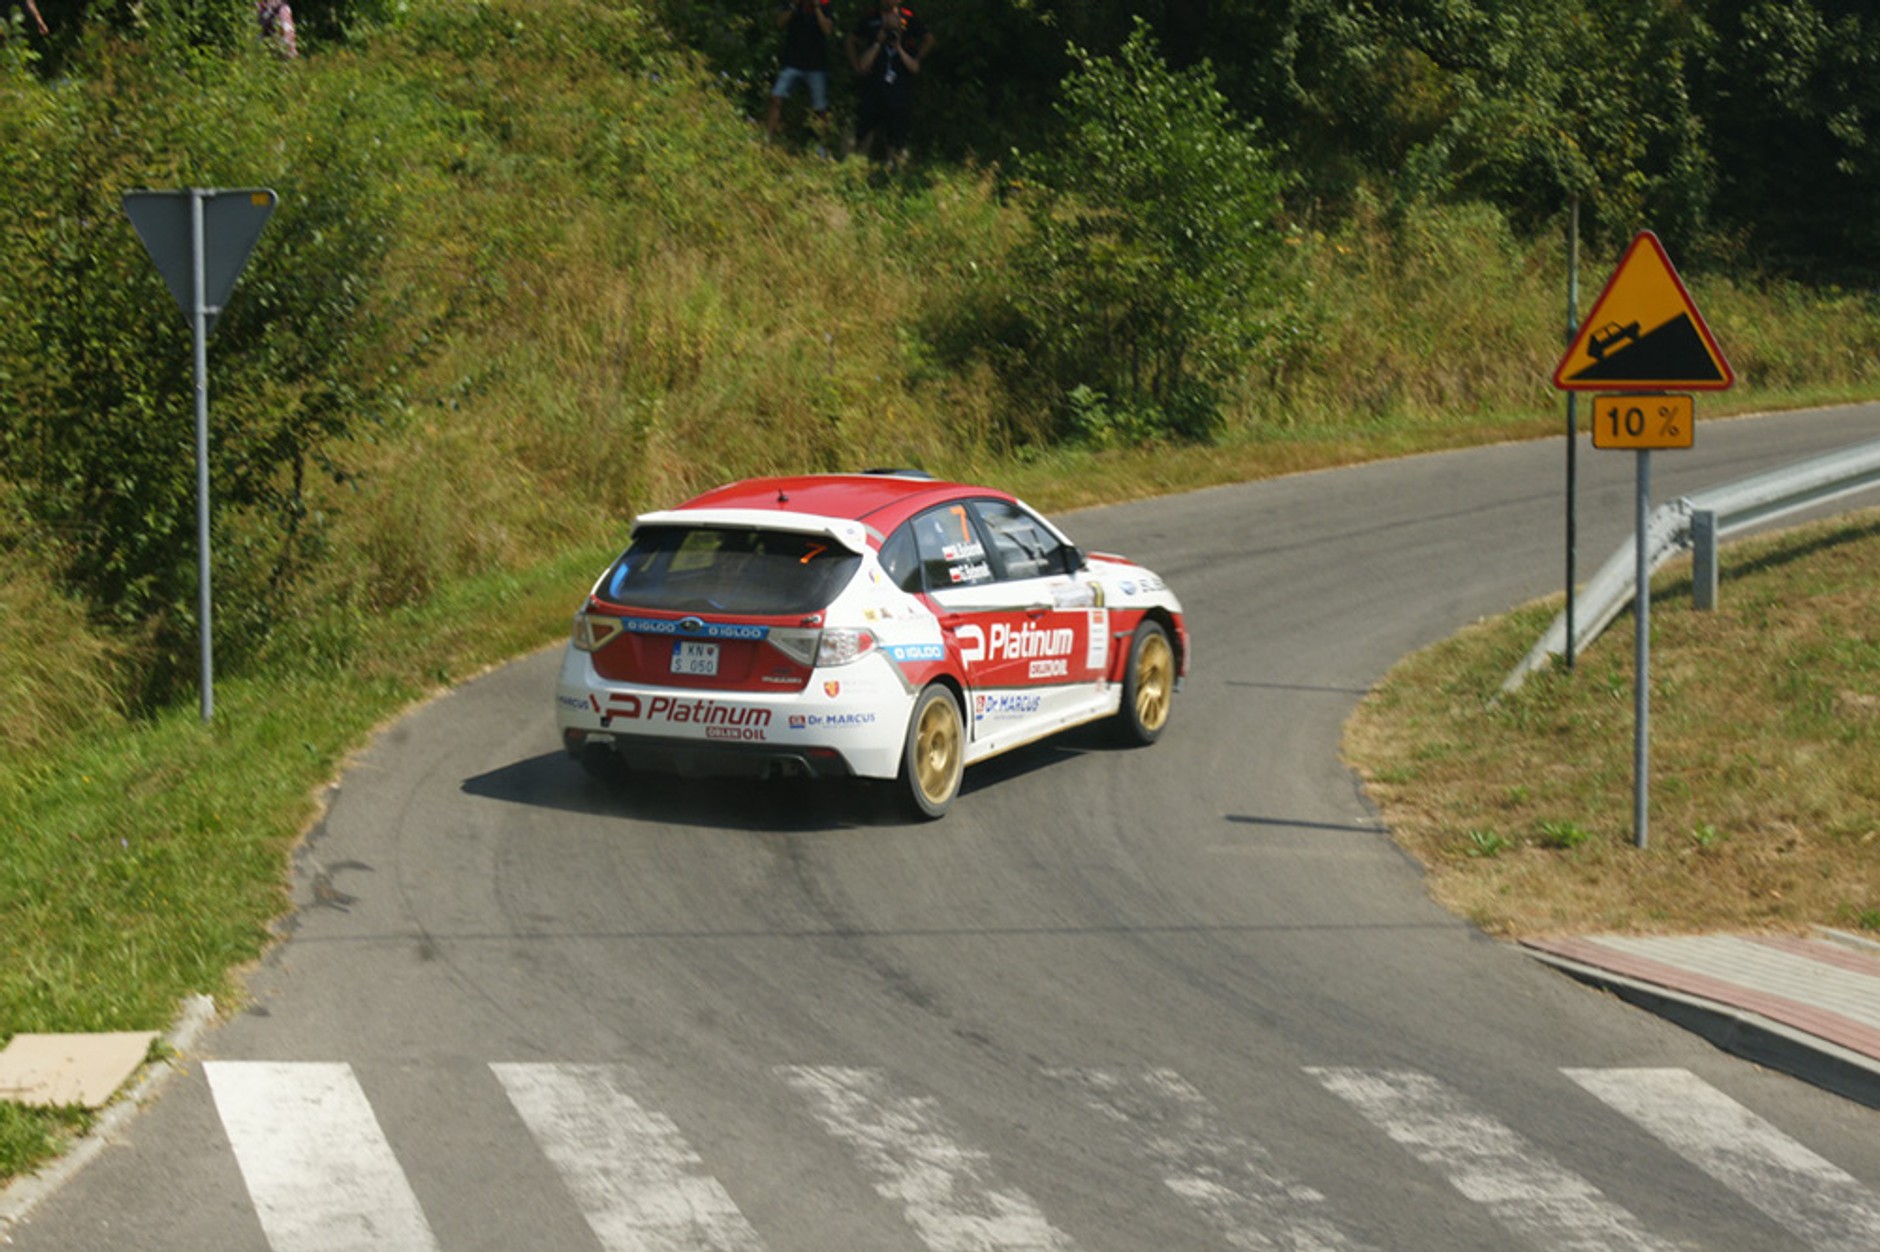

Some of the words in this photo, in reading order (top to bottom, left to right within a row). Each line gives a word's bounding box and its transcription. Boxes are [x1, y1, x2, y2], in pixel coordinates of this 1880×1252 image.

[1607, 406, 1645, 437] 10
[1658, 406, 1680, 437] %
[639, 621, 676, 634] IGLOO
[720, 628, 762, 639] IGLOO
[988, 621, 1074, 661] Platinum
[687, 645, 703, 657] KN
[907, 647, 941, 660] IGLOO
[675, 658, 682, 671] S
[690, 659, 713, 673] 050
[646, 695, 772, 727] Platinum
[826, 713, 876, 724] MARCUS
[743, 728, 766, 741] OIL
